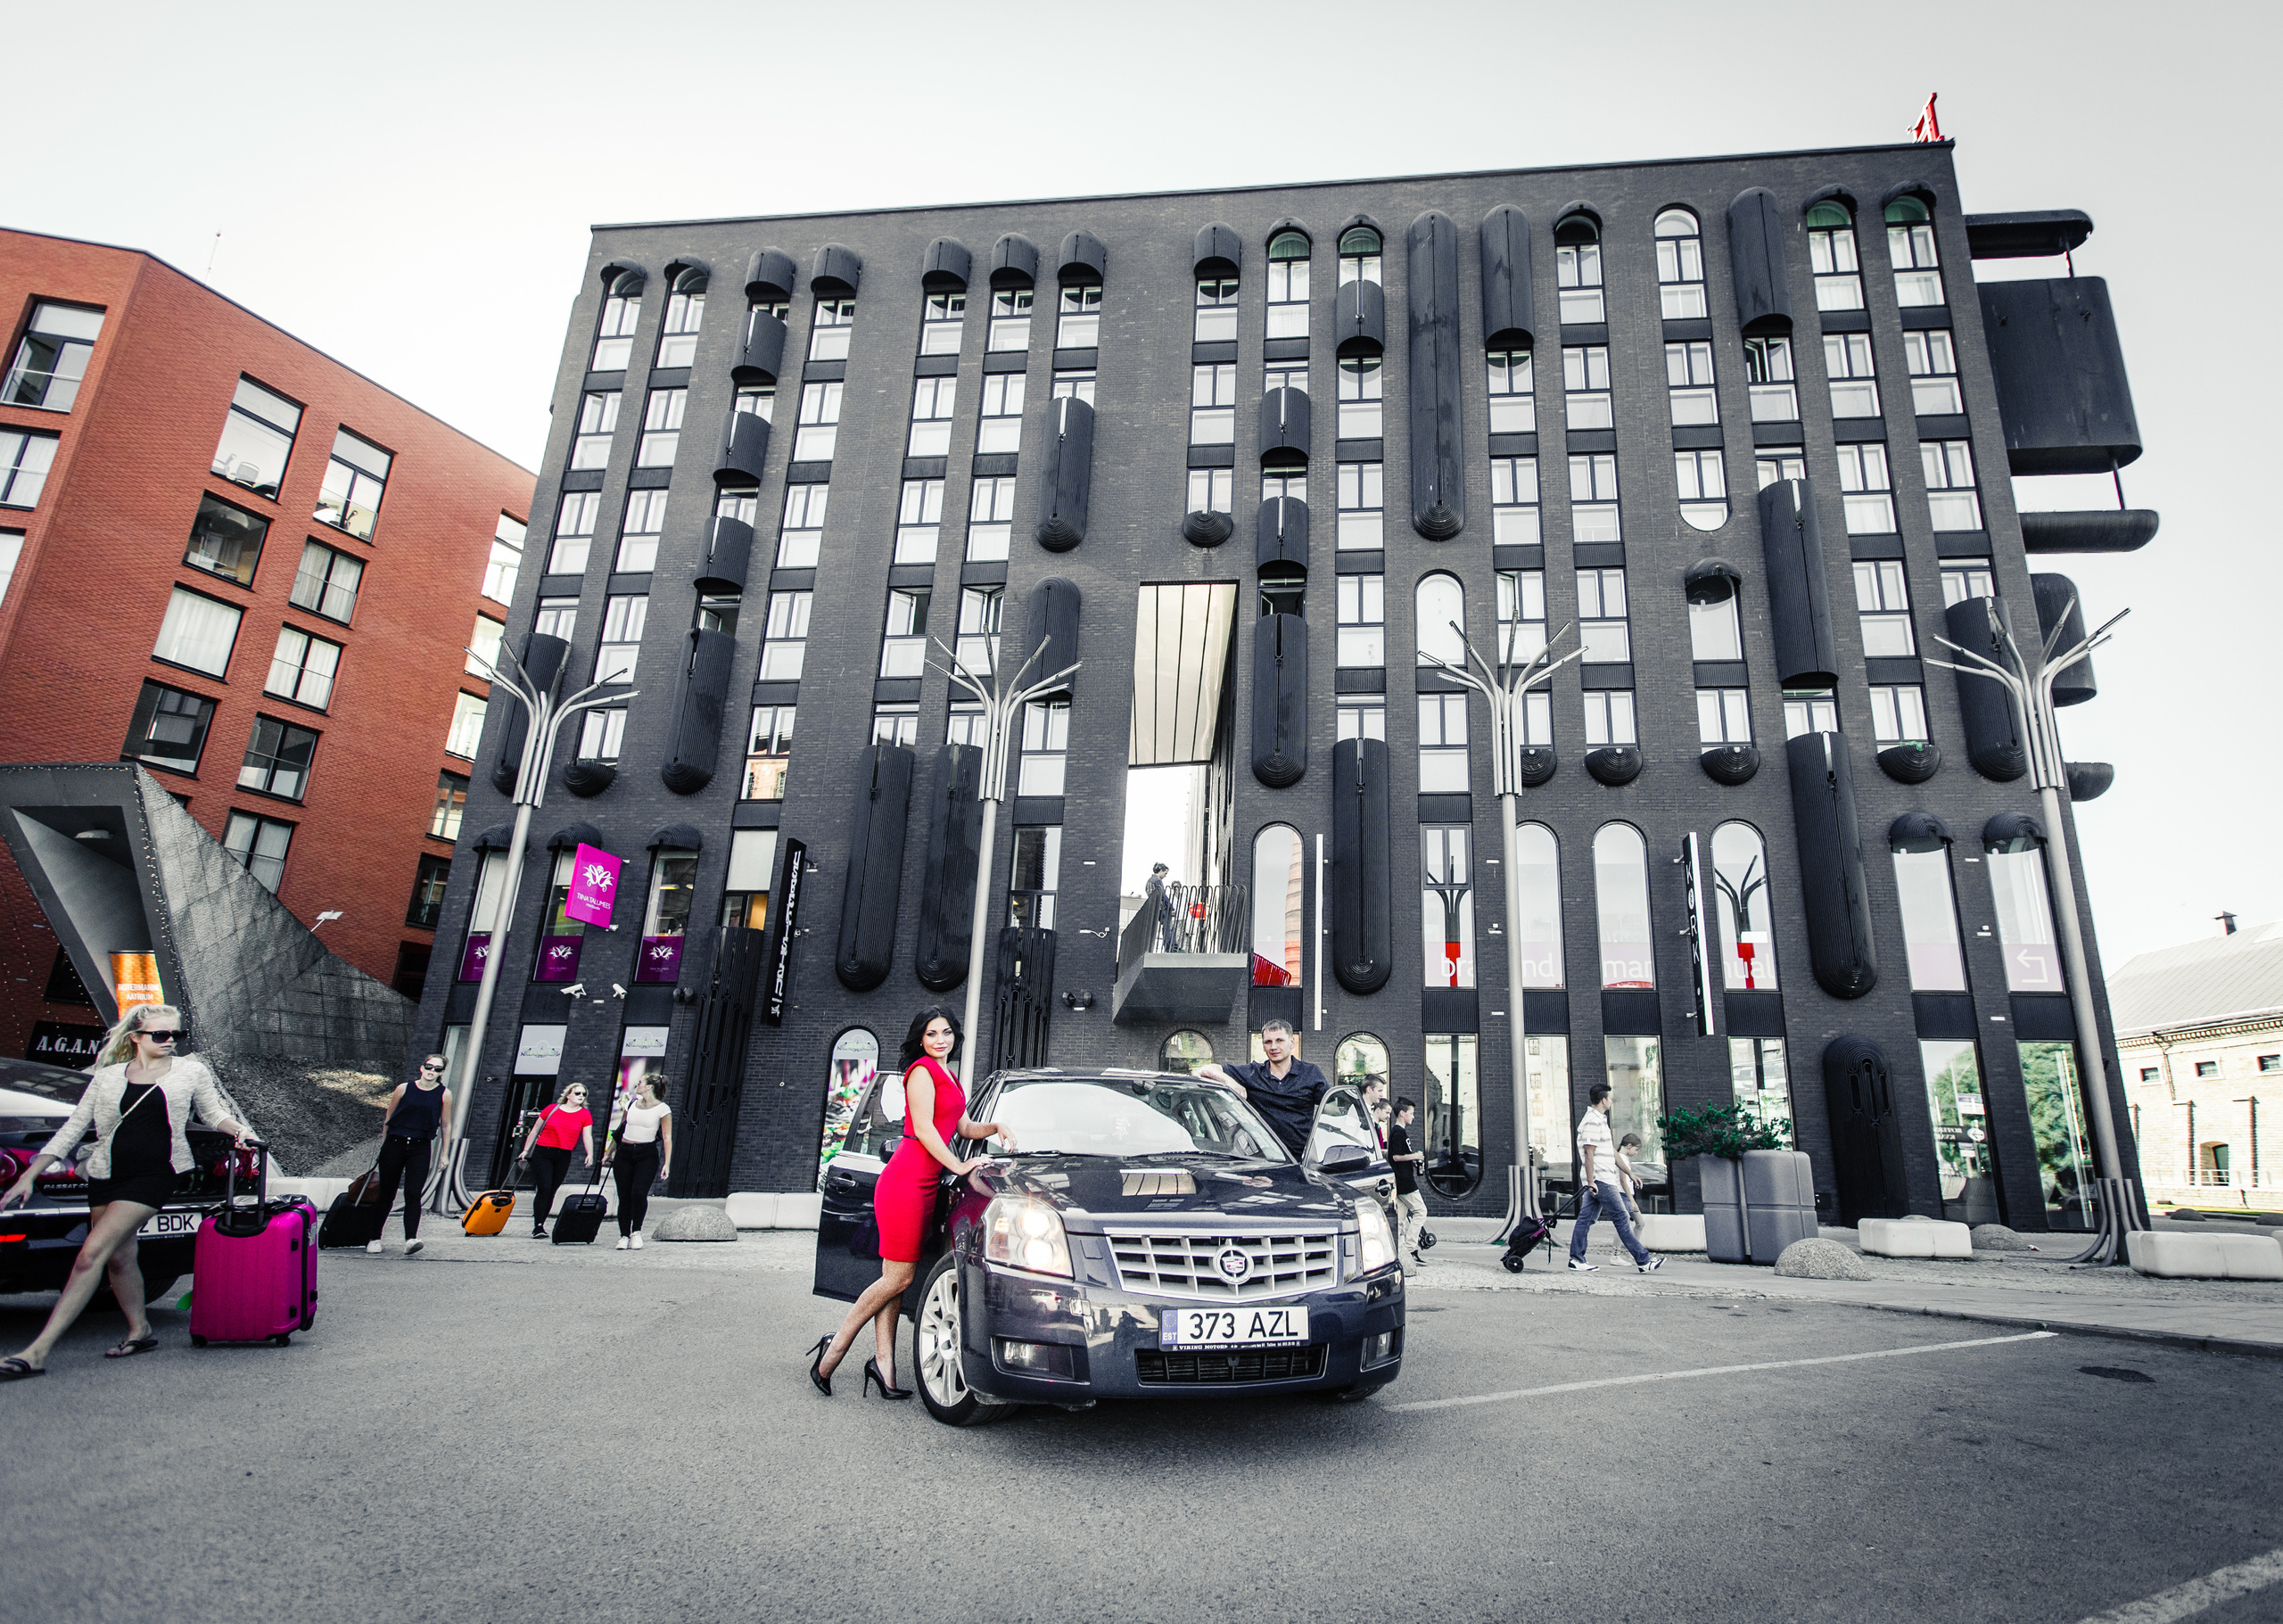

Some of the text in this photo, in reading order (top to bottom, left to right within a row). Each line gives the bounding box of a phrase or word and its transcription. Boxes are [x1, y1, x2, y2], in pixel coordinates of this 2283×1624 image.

[157, 1214, 195, 1232] BDK
[1189, 1310, 1298, 1340] 373 AZL
[1162, 1331, 1177, 1340] EST
